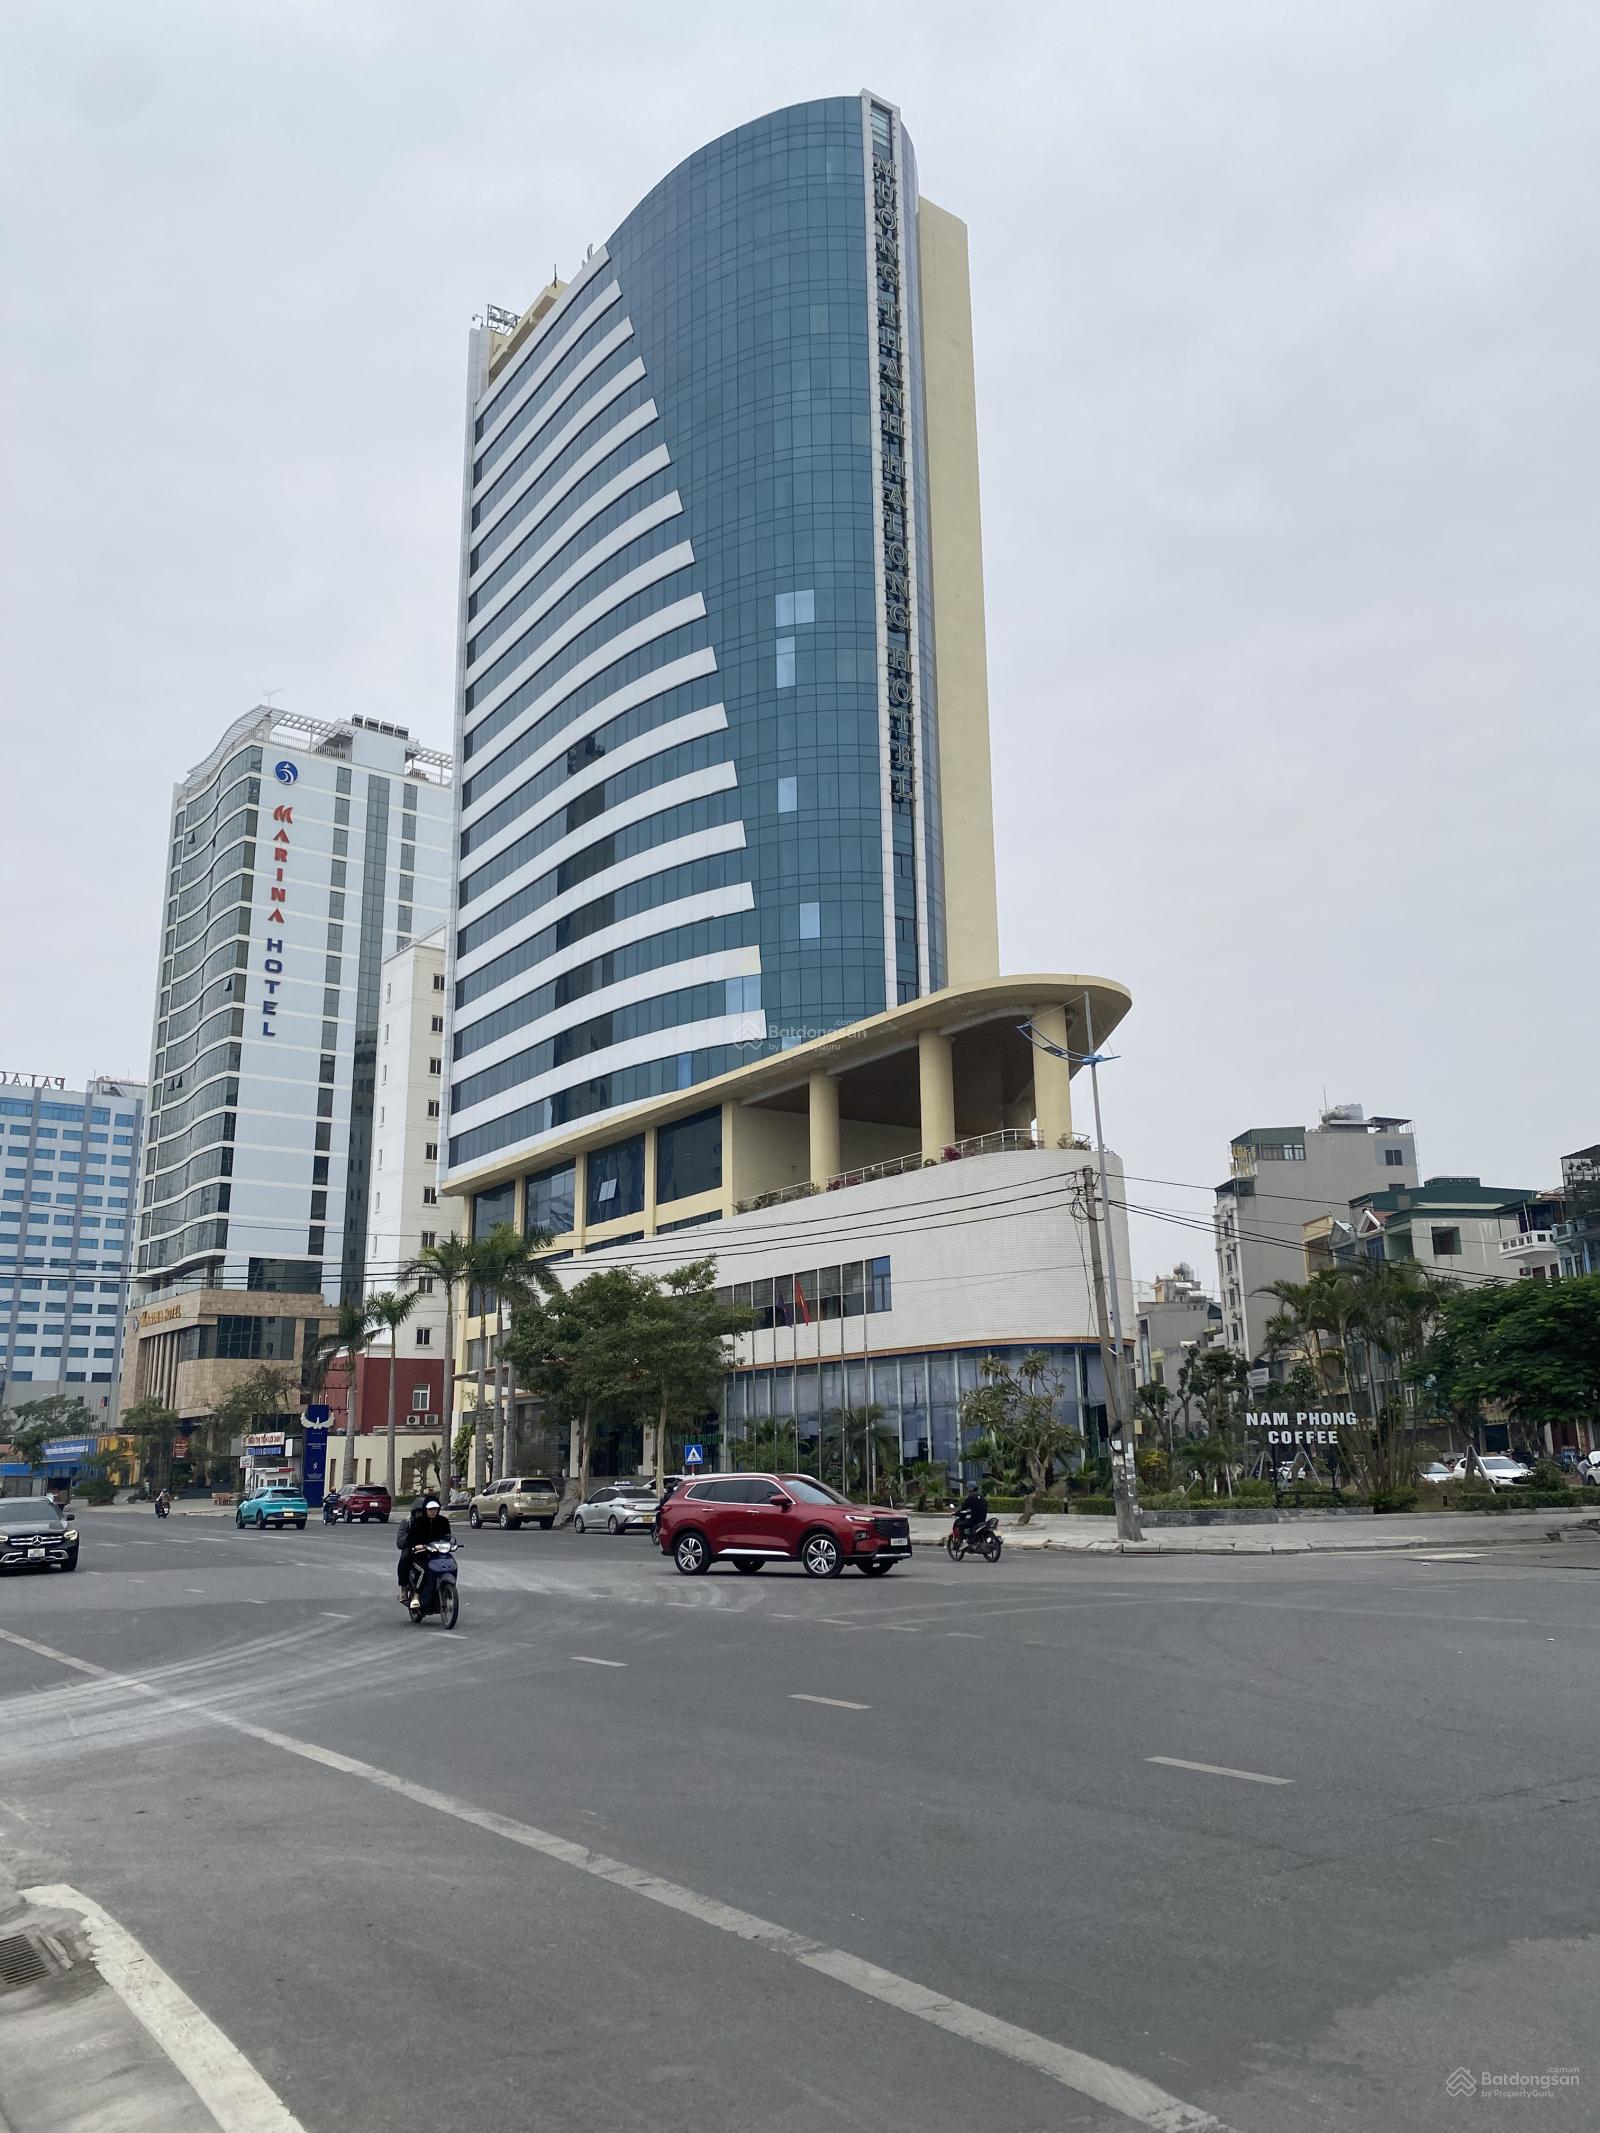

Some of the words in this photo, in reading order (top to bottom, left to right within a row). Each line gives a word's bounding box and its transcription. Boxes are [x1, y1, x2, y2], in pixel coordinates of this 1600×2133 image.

[880, 298, 904, 438] THANH
[889, 645, 913, 799] HOTEL
[267, 805, 294, 924] MARINA
[262, 938, 283, 1037] HOTEL
[1245, 1412, 1289, 1426] NAM
[1296, 1412, 1357, 1426] PHONG
[1268, 1430, 1339, 1445] COFFEE
